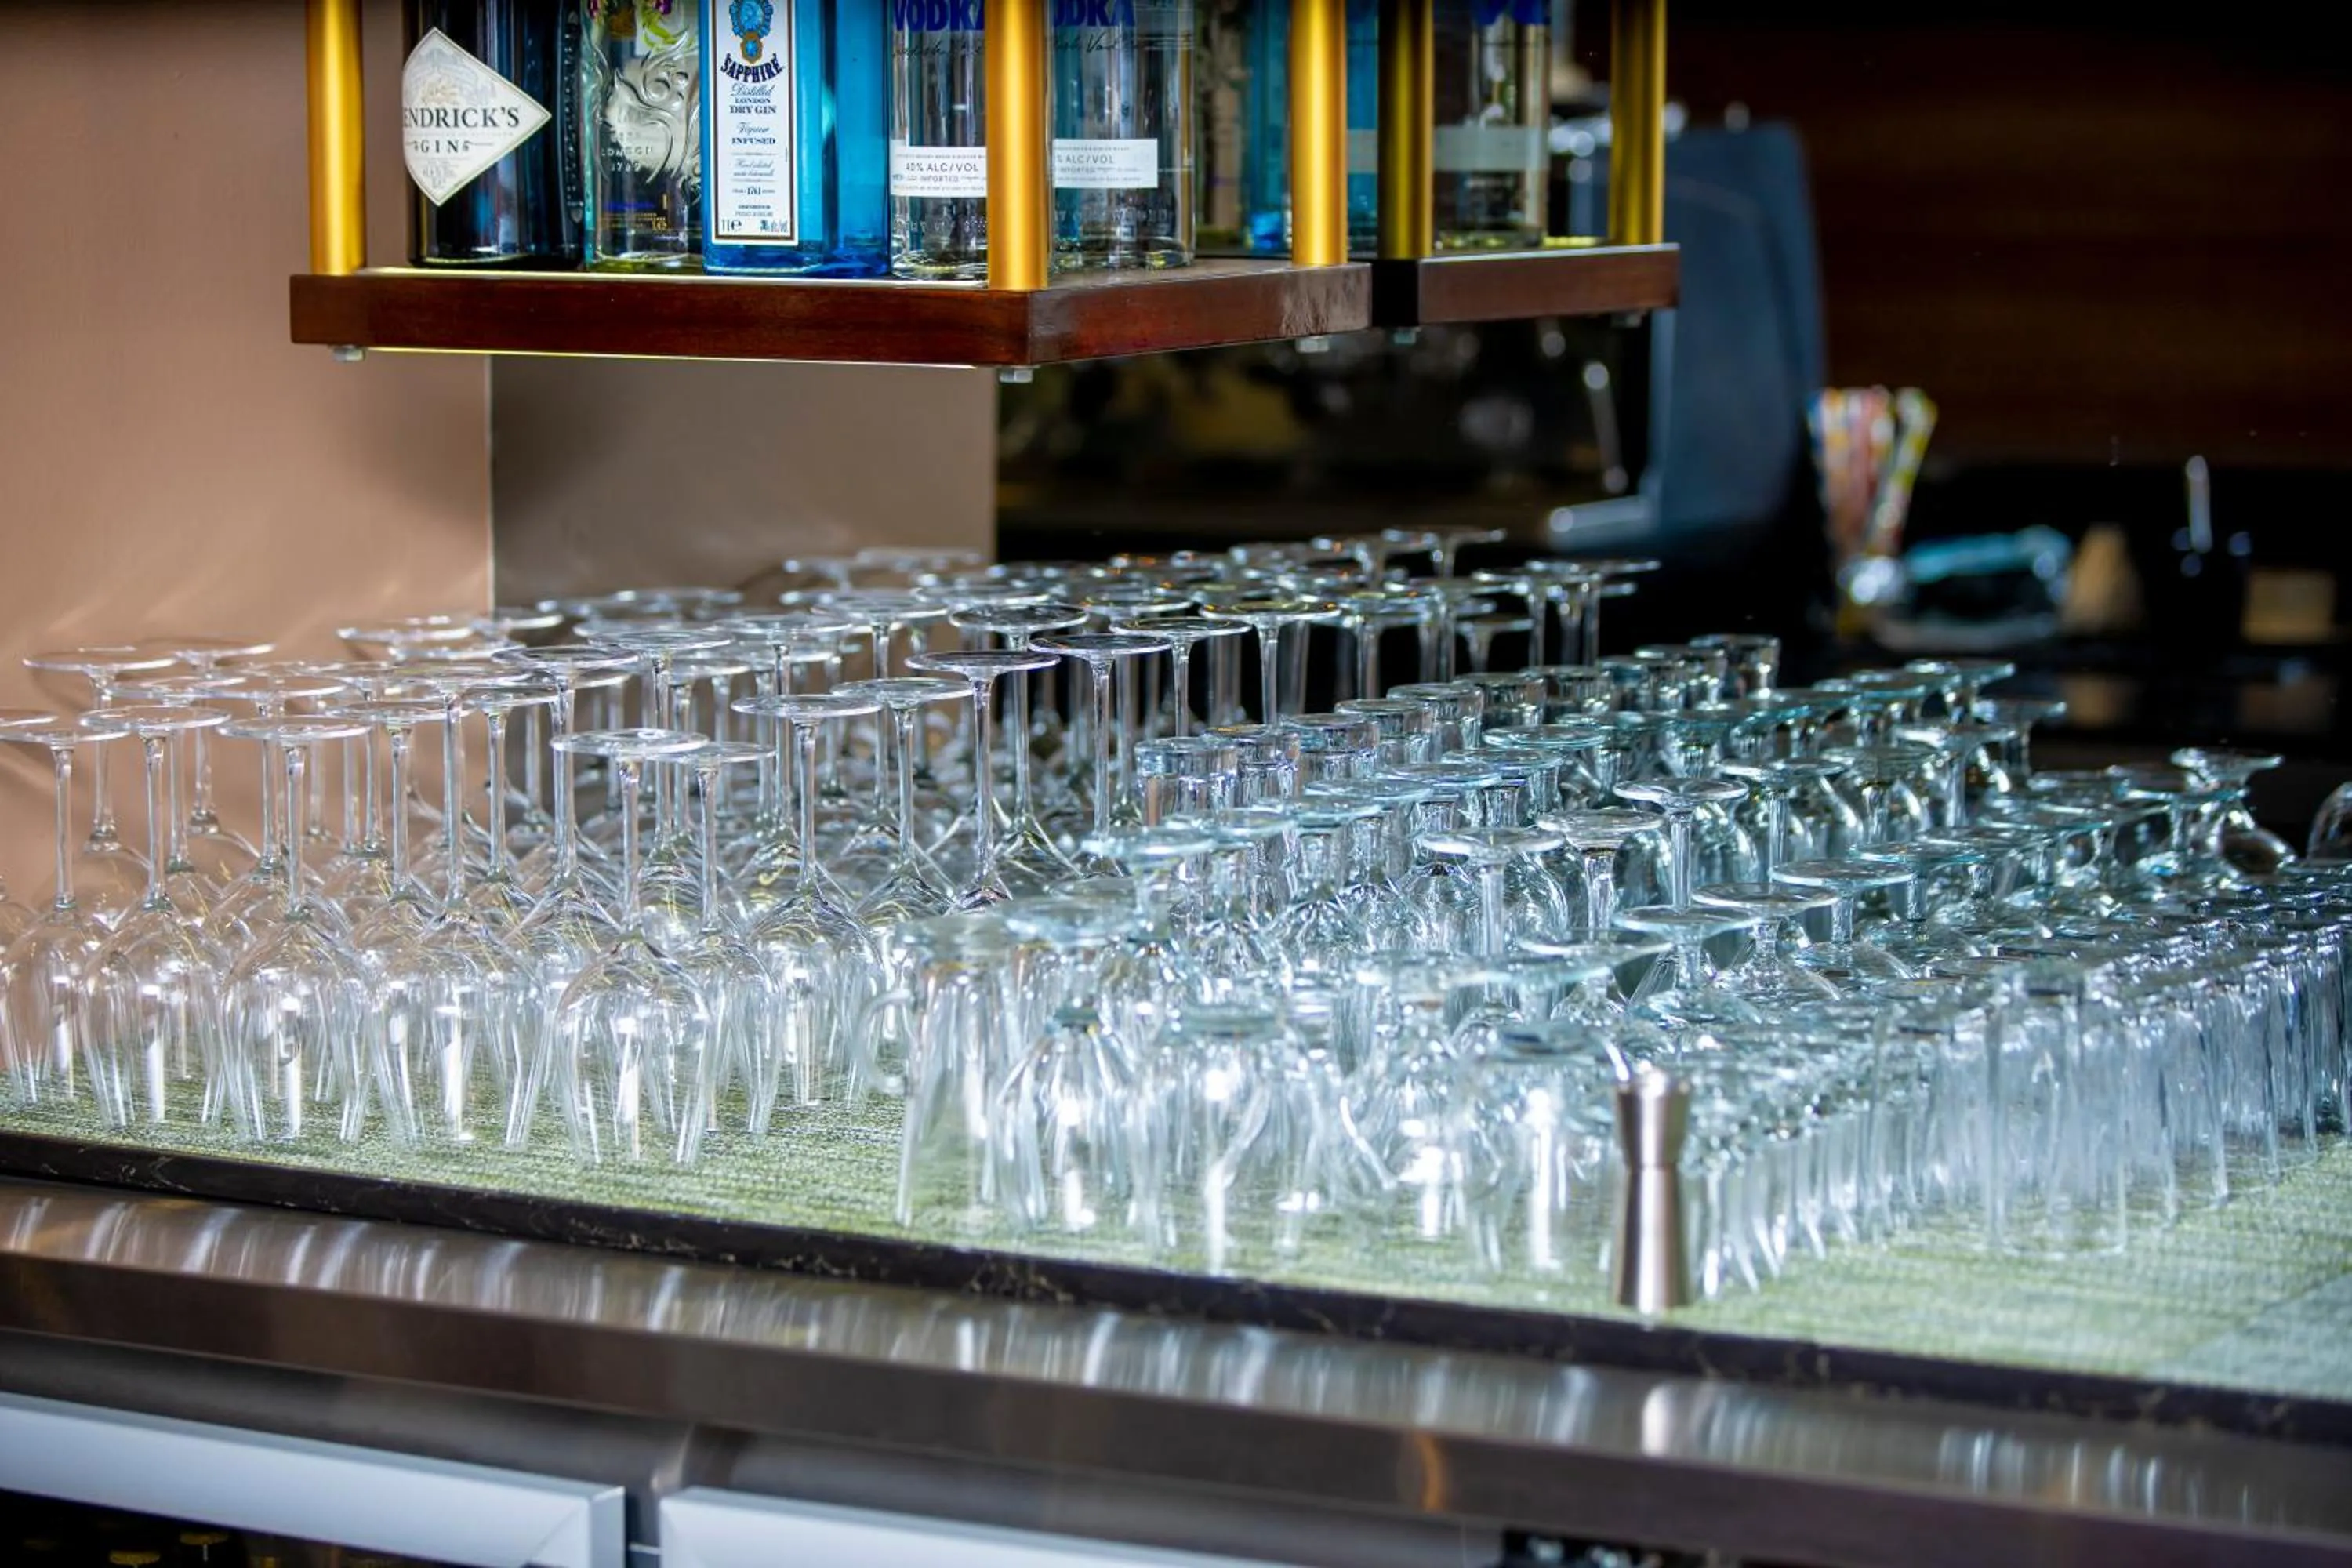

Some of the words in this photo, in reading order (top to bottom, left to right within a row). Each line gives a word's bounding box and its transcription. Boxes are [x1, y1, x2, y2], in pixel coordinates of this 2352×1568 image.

[1054, 0, 1135, 27] DKA
[720, 53, 785, 82] SAPPHIRE
[404, 107, 519, 128] ENDRICK'S
[729, 105, 753, 114] DRY
[755, 105, 776, 114] GIN
[421, 140, 459, 153] GIN
[927, 162, 979, 172] ALC/VOL
